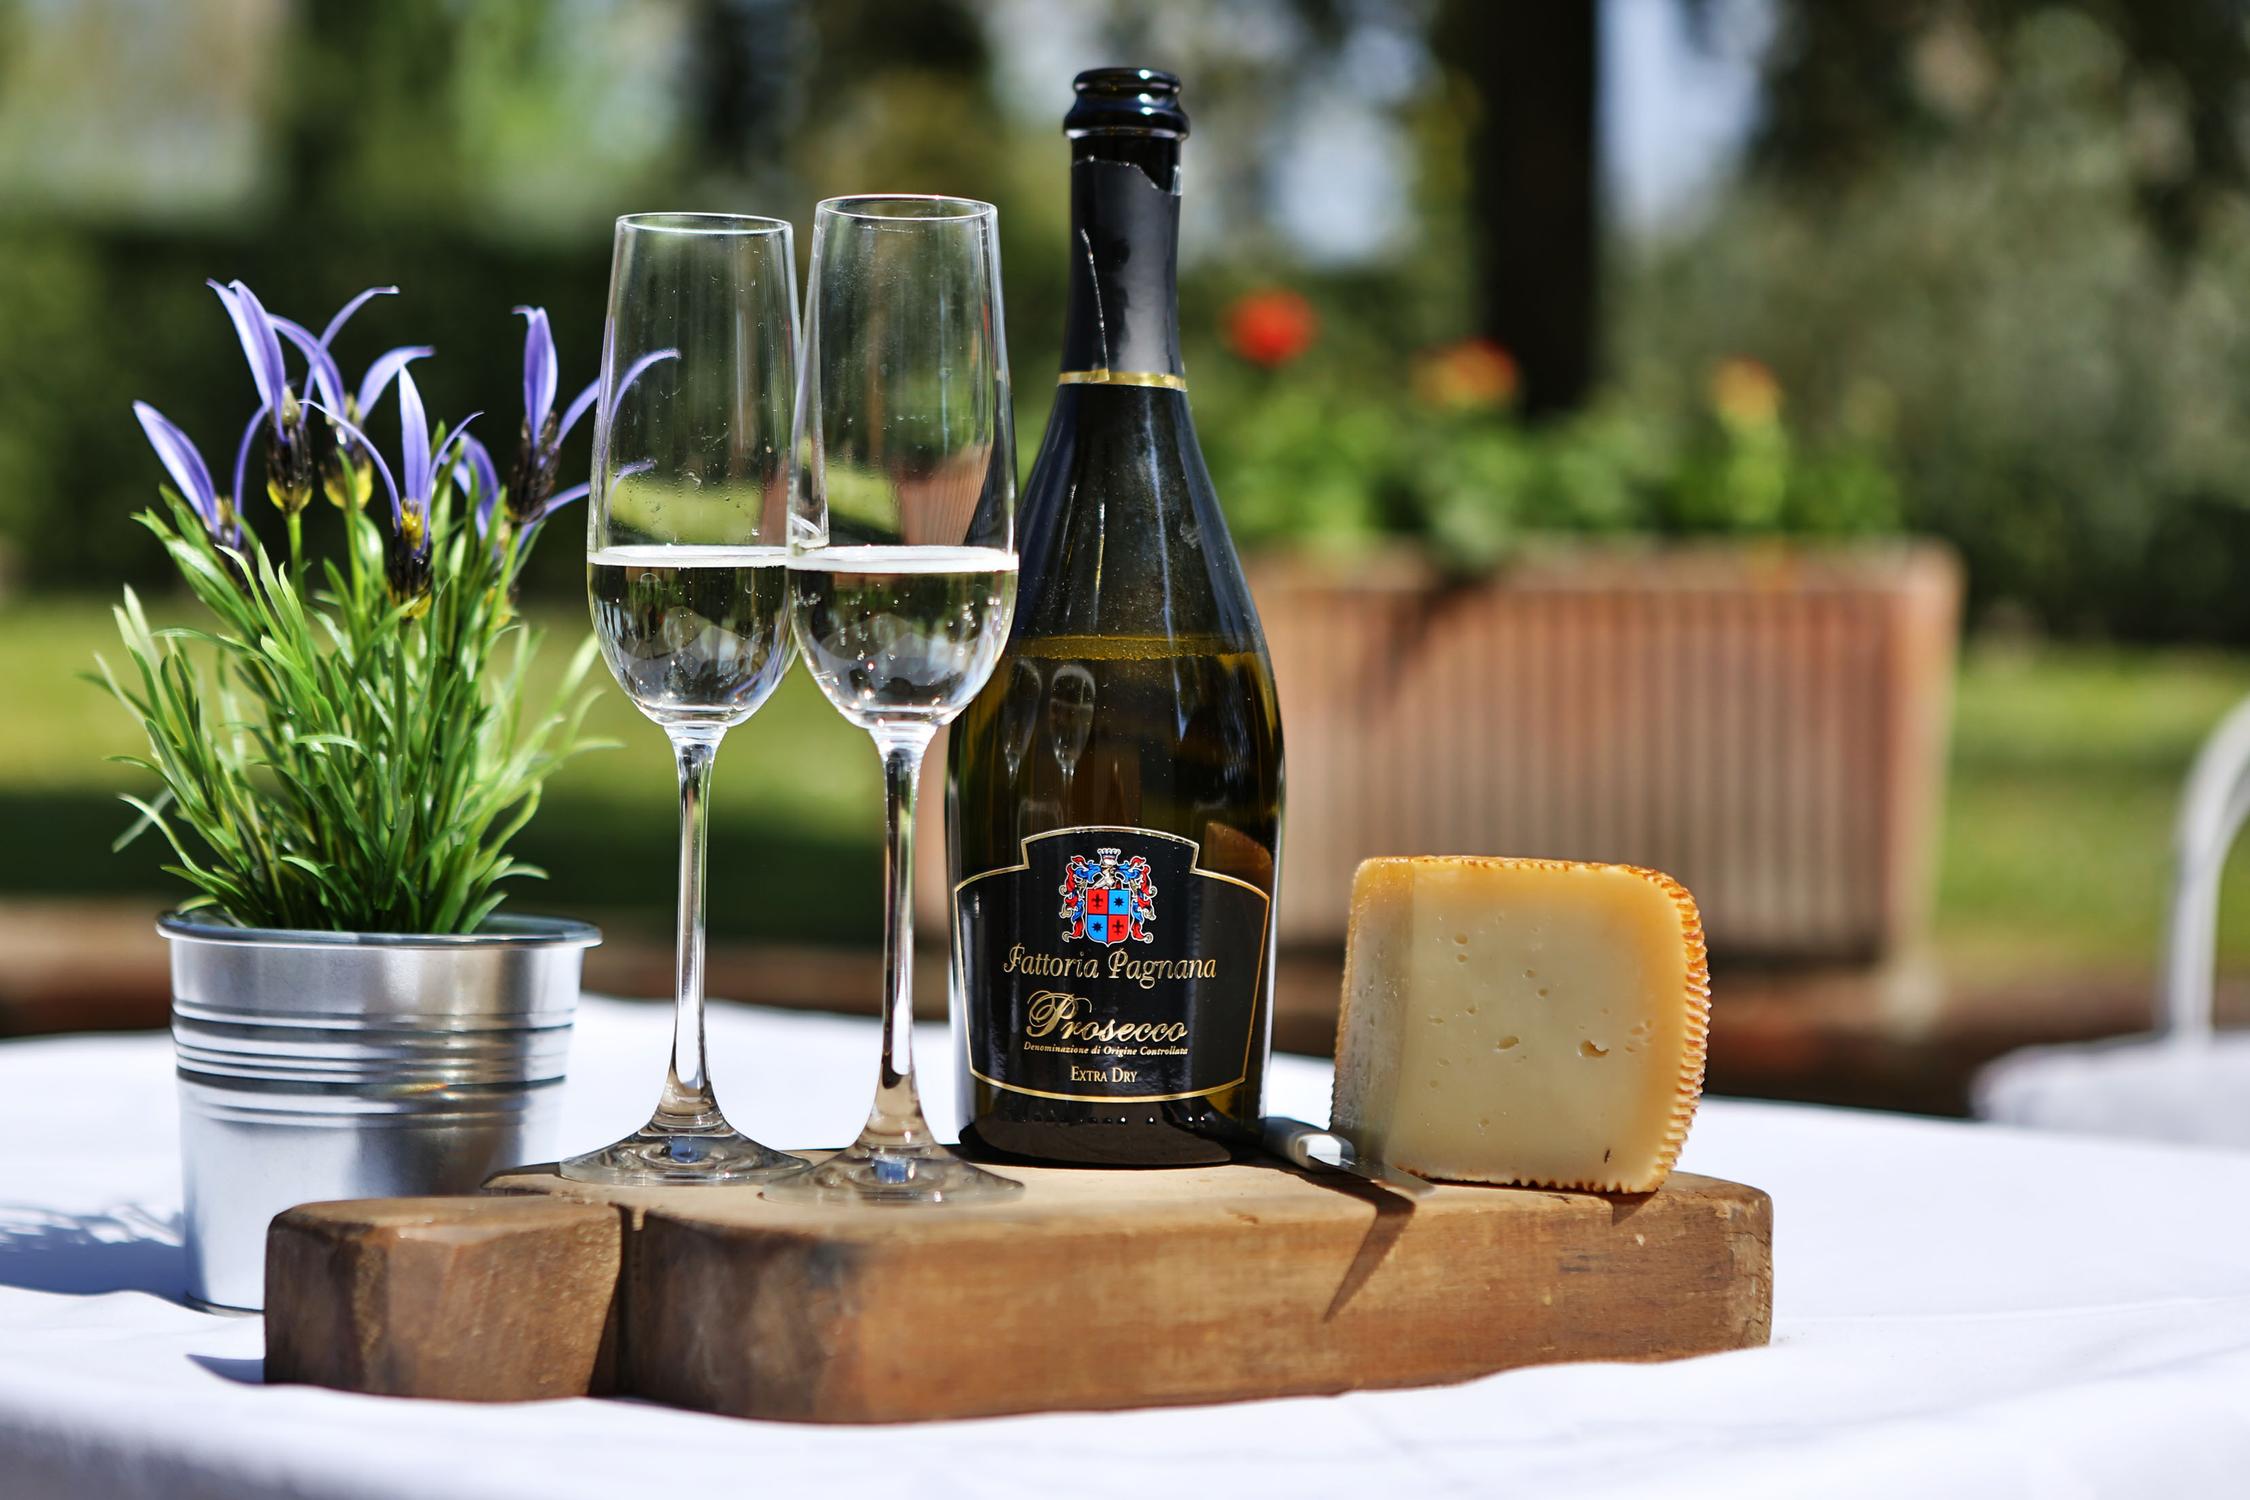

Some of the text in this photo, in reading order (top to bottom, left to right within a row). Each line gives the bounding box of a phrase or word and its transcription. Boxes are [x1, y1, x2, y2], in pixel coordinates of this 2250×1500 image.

[1003, 942, 1217, 990] Fattoria Pagnana
[1025, 990, 1188, 1042] Prosecco
[1023, 1041, 1189, 1058] Denominazione di Origine Controllata
[1070, 1065, 1138, 1084] EXTRA DRY
